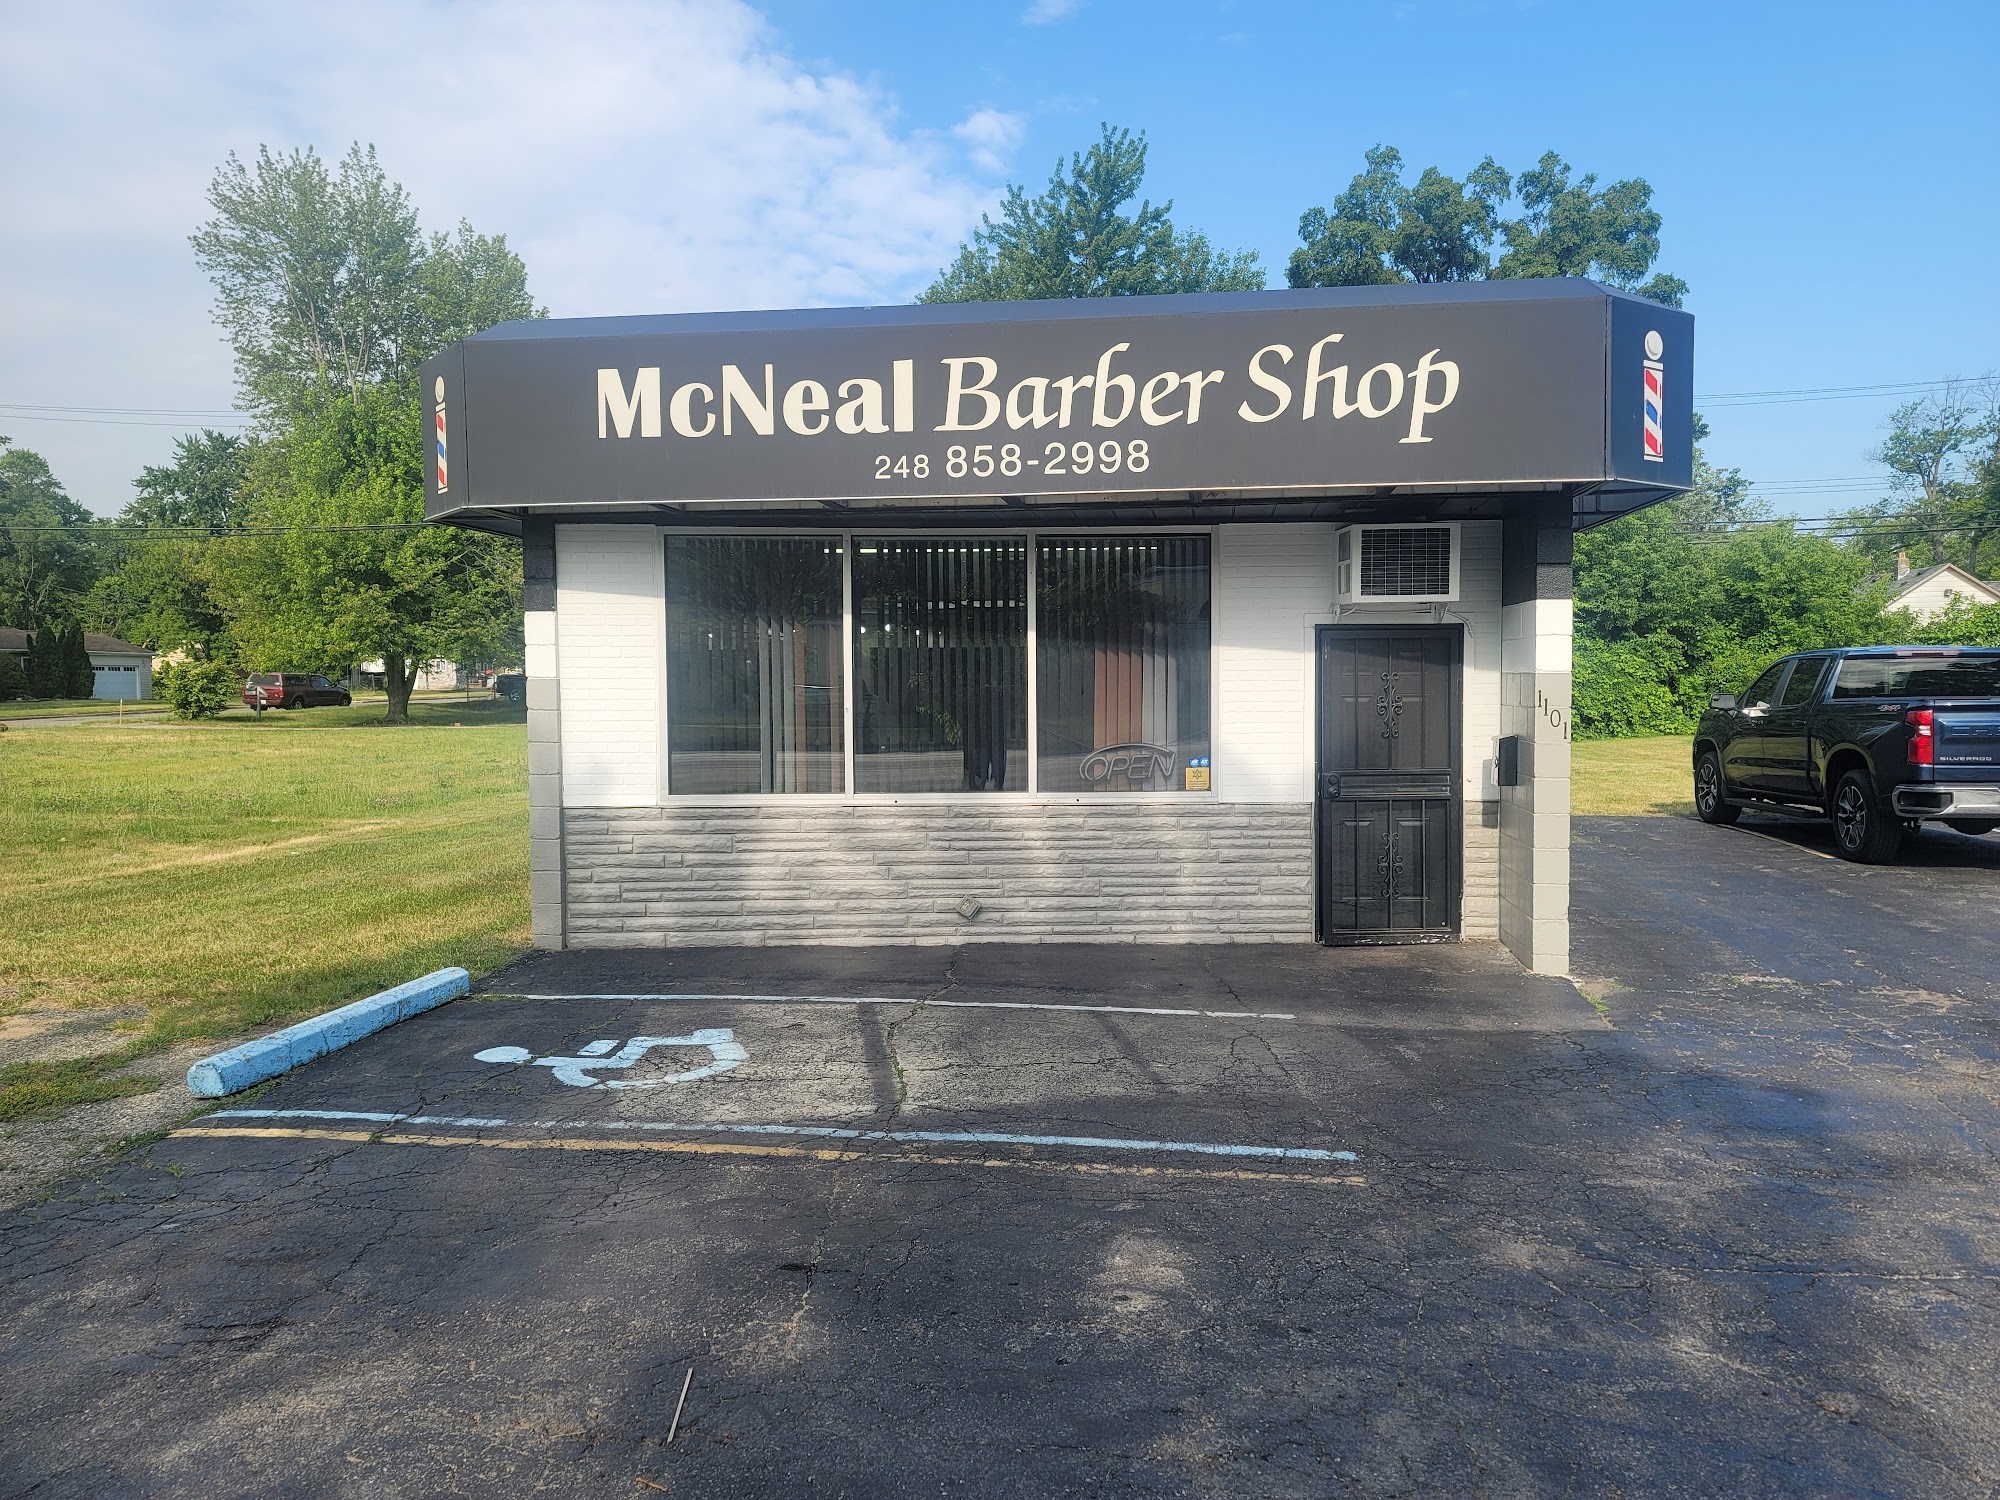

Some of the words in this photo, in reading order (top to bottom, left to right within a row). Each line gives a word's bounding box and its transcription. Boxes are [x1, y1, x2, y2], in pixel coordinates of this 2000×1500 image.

[597, 358, 914, 439] McNeal
[933, 343, 1225, 432] Barber
[1238, 334, 1461, 445] Shop
[874, 455, 931, 480] 248
[945, 440, 1150, 478] 858-2998
[1538, 690, 1568, 740] 1101
[1085, 754, 1176, 780] OPEN
